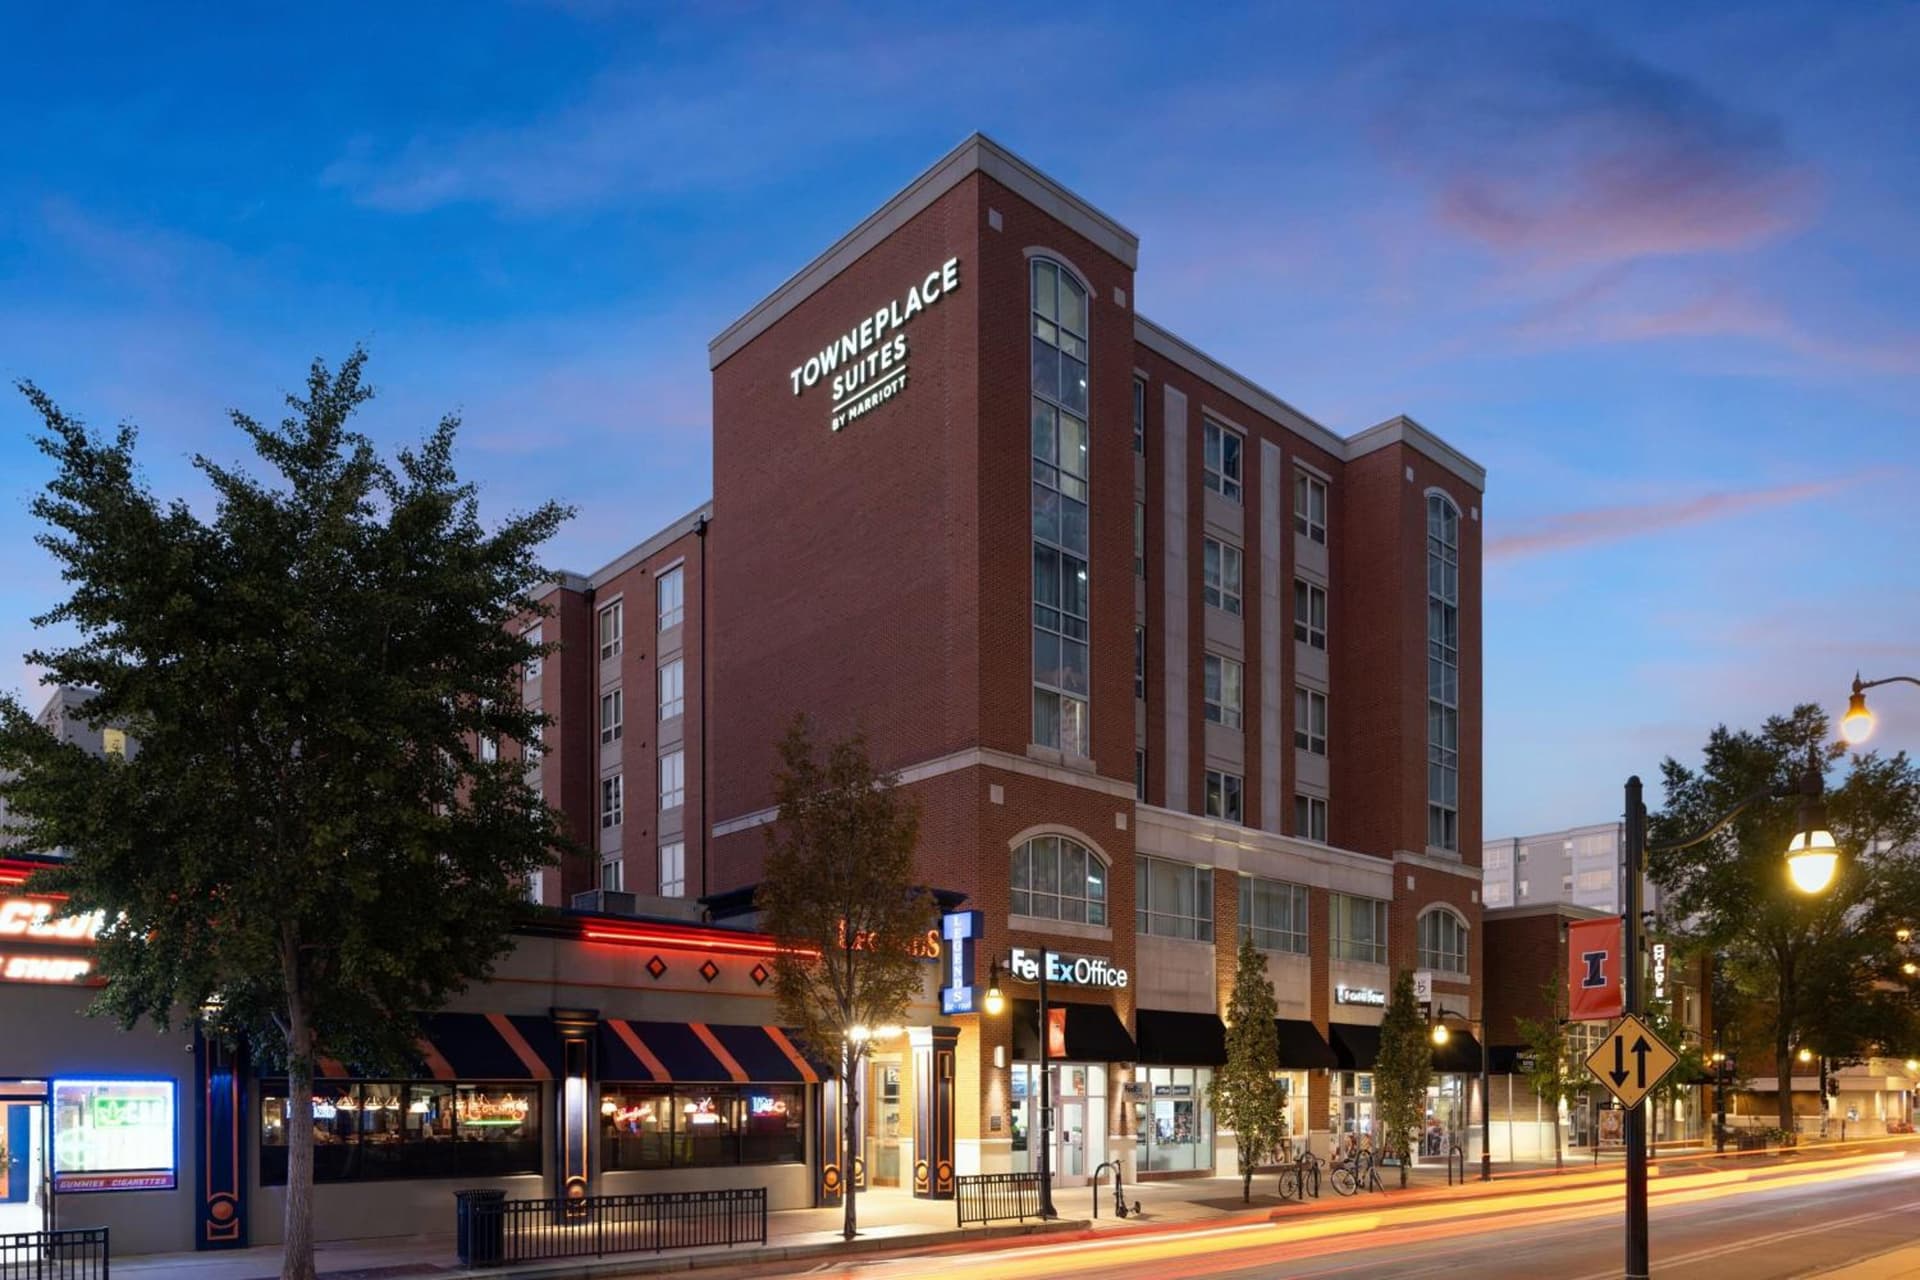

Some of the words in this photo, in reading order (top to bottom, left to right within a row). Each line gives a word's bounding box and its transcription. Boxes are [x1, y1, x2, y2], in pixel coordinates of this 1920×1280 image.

[790, 257, 958, 395] TOWNEPLACE
[832, 334, 906, 401] SUITES
[832, 413, 846, 431] BY
[849, 375, 906, 420] MARRIOTT
[1075, 958, 1128, 987] Office
